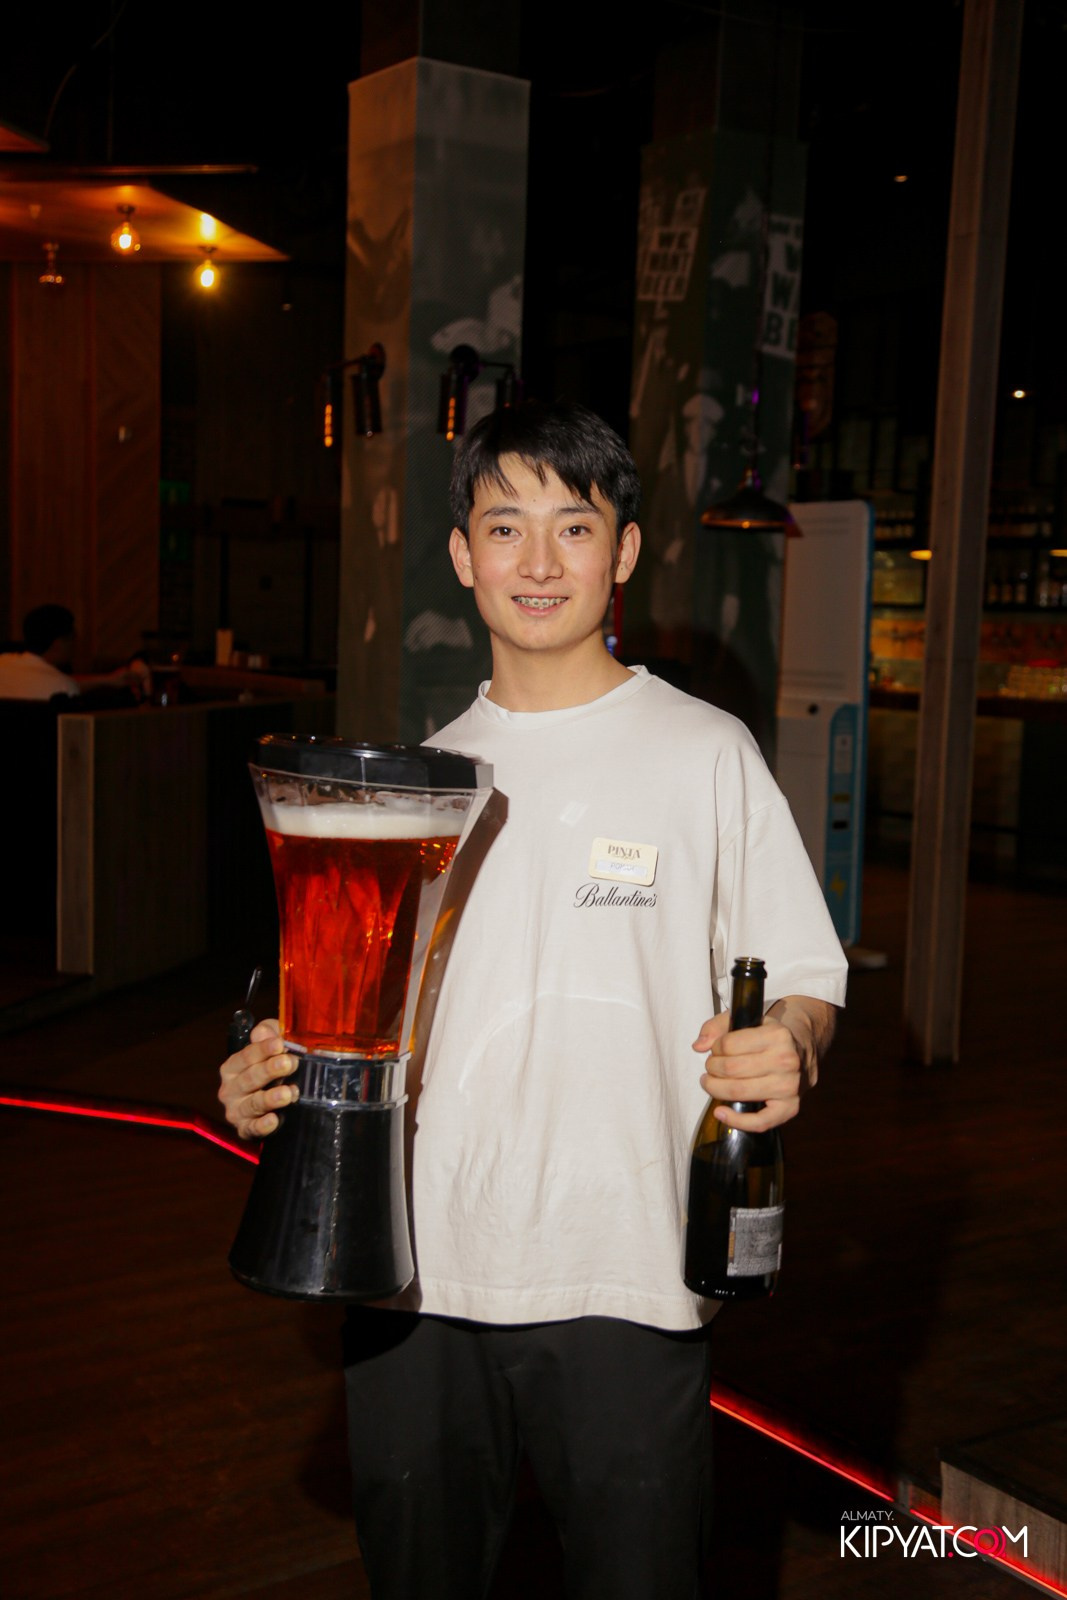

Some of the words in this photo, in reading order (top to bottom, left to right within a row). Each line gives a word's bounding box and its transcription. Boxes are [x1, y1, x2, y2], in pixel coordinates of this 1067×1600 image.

[658, 231, 690, 249] WE
[608, 845, 642, 859] PINTA
[573, 882, 658, 908] Ballantine's
